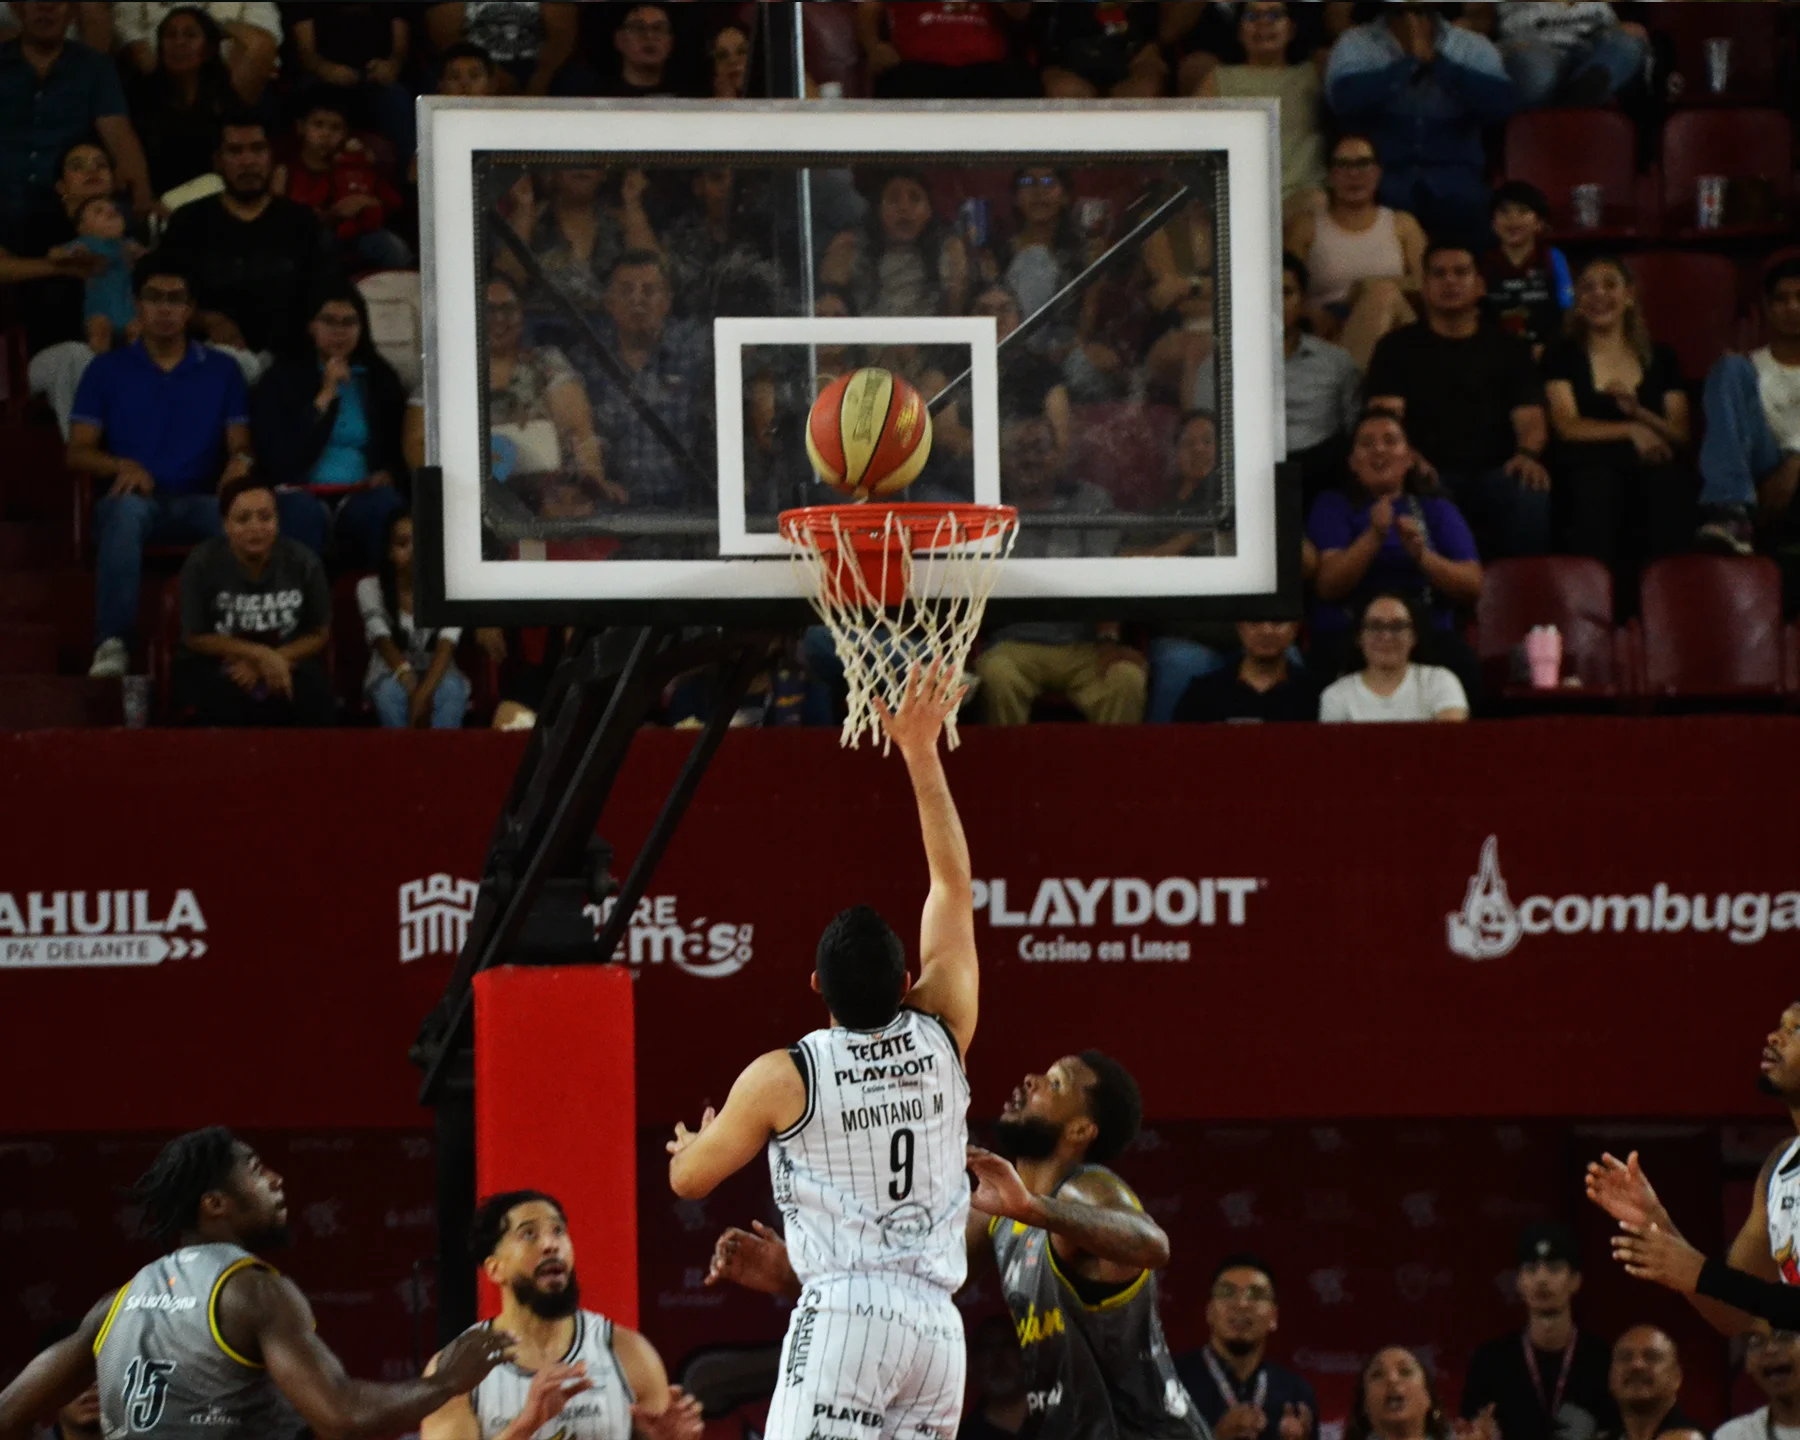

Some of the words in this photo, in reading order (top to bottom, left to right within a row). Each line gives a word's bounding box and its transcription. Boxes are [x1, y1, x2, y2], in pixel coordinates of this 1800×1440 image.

[1519, 881, 1800, 945] combuga
[46, 939, 150, 961] DELANTE
[1018, 934, 1092, 962] Casino
[1097, 940, 1126, 962] en
[847, 1031, 916, 1063] TECATE
[834, 1054, 935, 1087] PLAYDOIT
[841, 1098, 923, 1133] MONTANO
[932, 1091, 944, 1116] M
[888, 1127, 915, 1201] 9
[122, 1354, 177, 1432] 15
